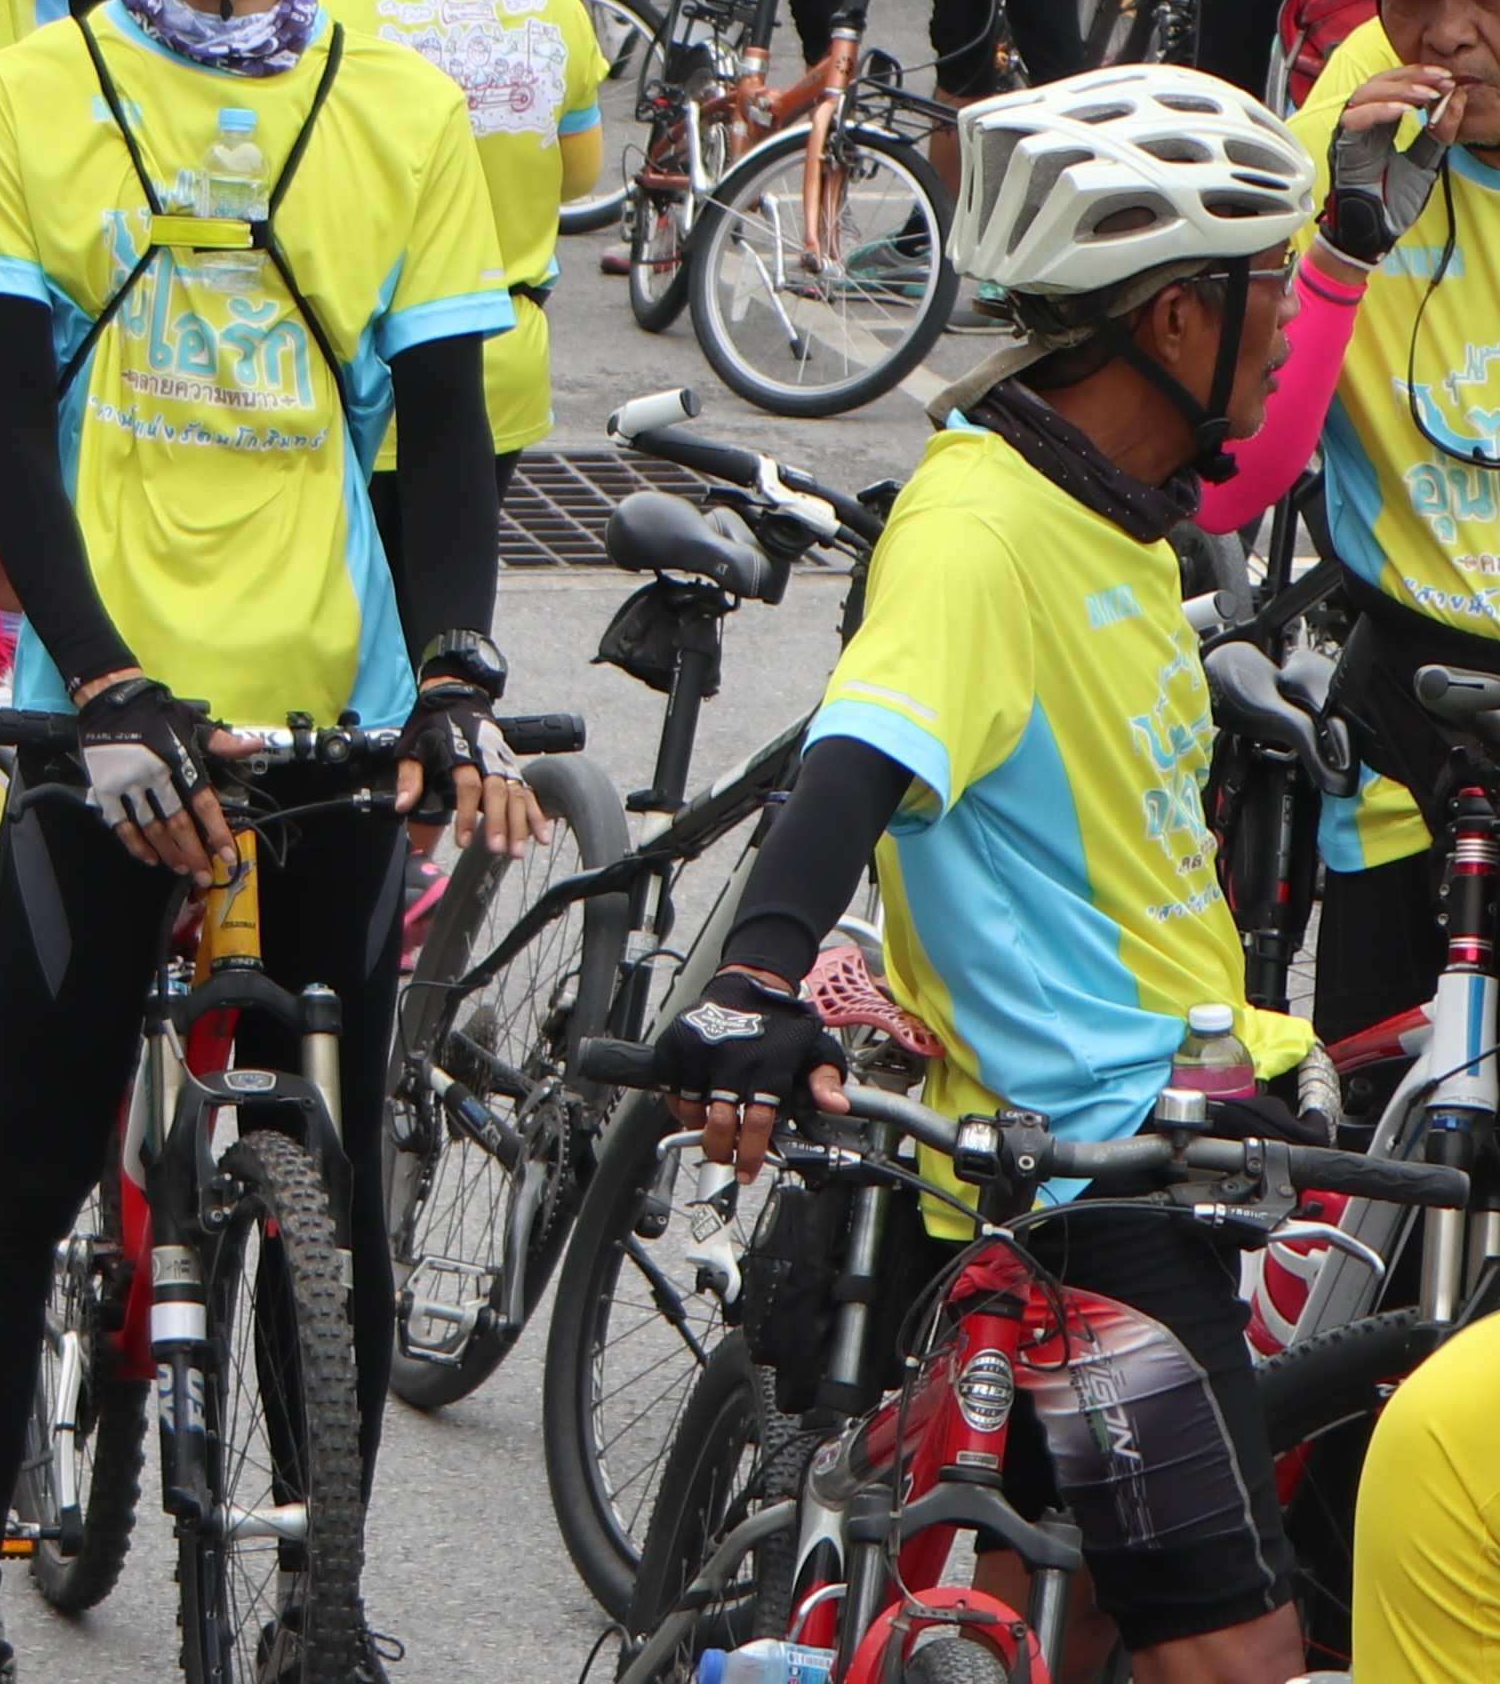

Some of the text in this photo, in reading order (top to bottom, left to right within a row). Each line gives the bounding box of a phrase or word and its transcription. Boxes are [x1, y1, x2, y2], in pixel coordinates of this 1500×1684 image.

[124, 370, 281, 411] คลายความหนาว
[960, 1381, 1011, 1399] TREK
